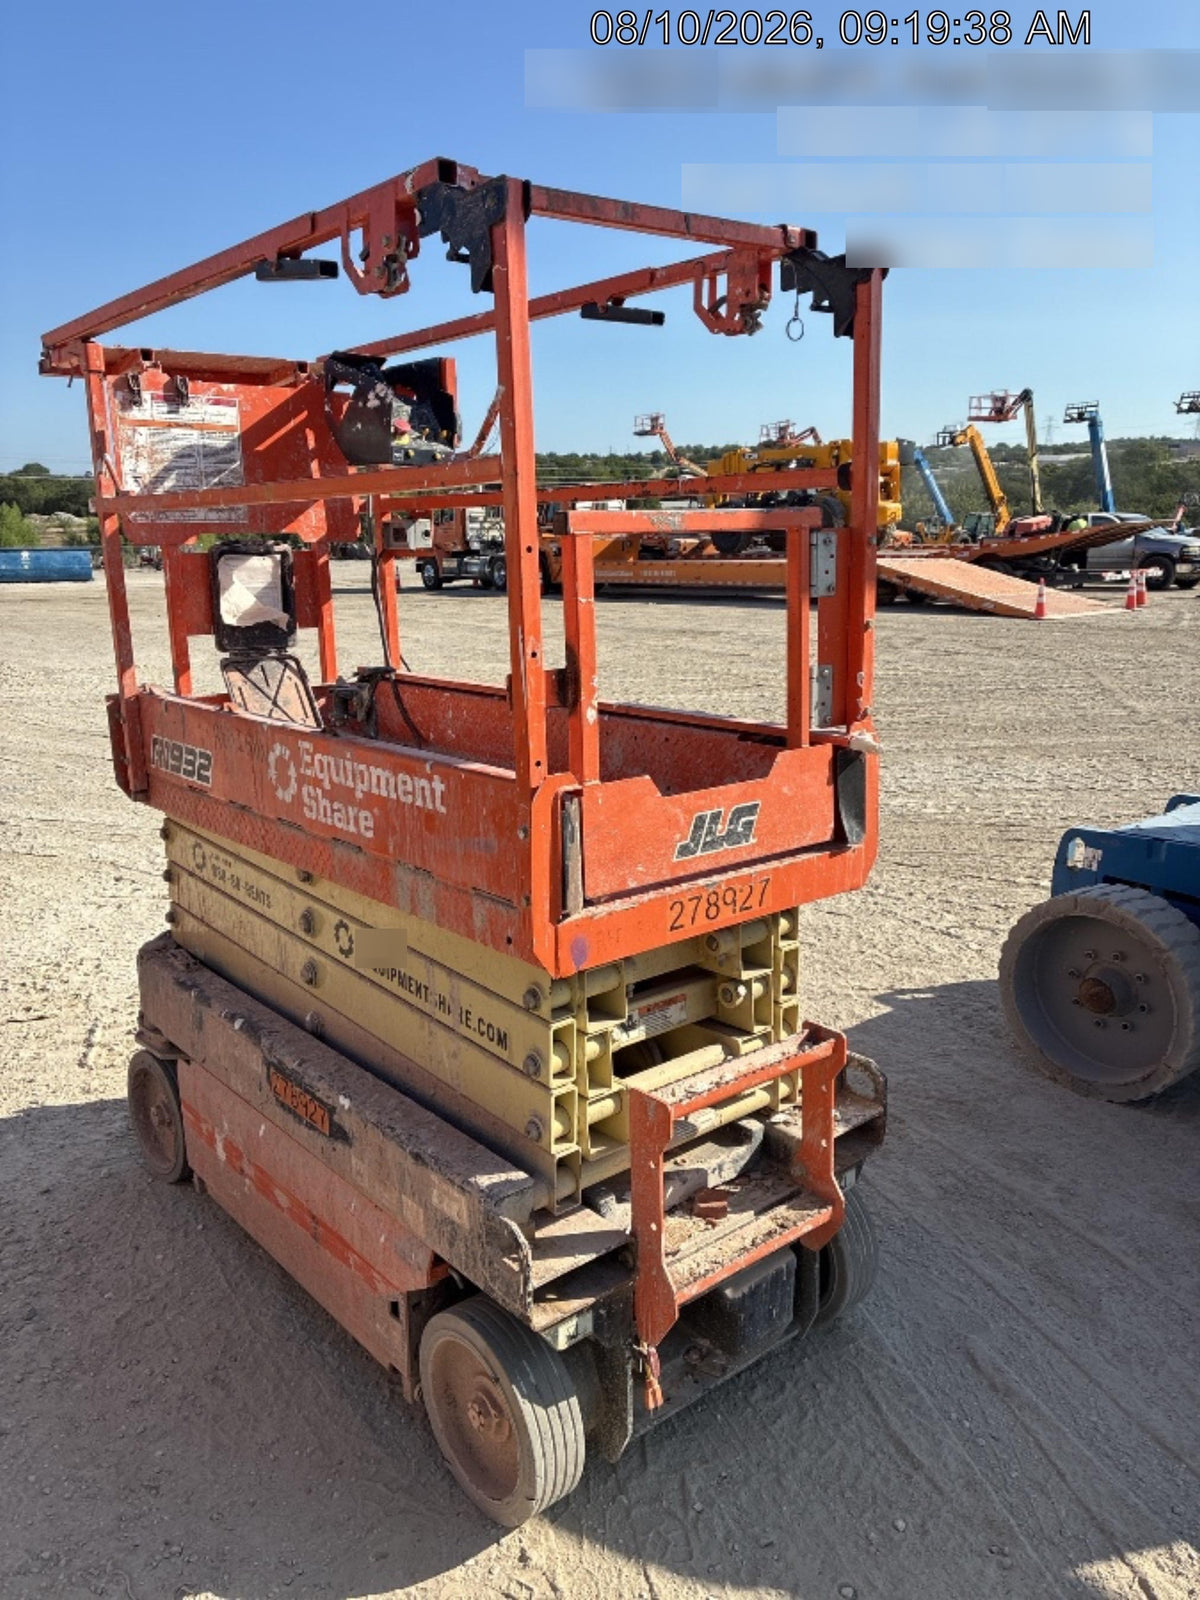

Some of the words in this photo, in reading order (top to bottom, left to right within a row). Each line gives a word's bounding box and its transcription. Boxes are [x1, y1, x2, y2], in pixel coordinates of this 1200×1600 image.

[298, 739, 447, 814] Equipment
[301, 783, 375, 838] Share
[673, 800, 761, 861] JLG
[669, 877, 771, 931] 278927
